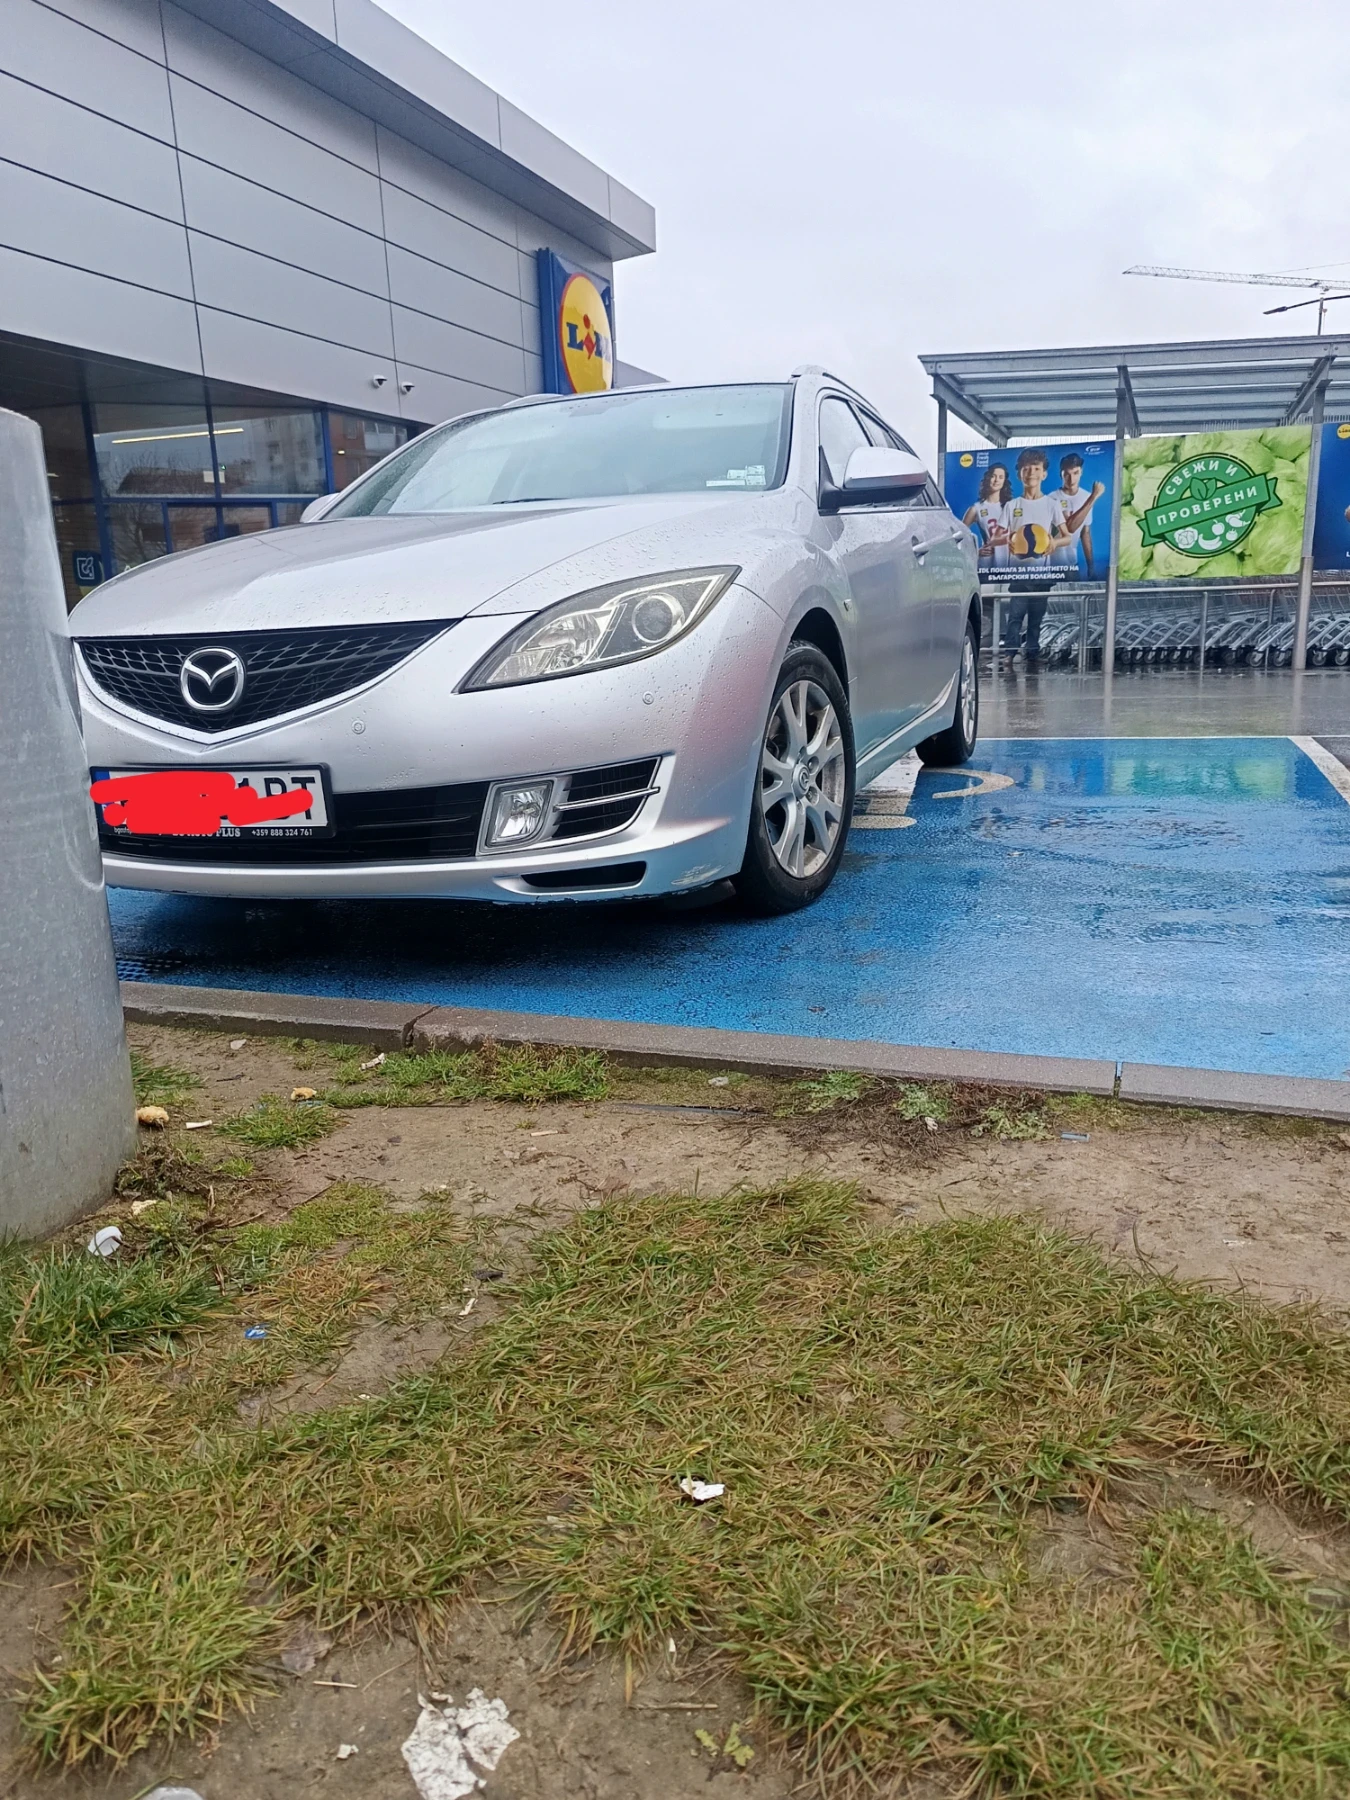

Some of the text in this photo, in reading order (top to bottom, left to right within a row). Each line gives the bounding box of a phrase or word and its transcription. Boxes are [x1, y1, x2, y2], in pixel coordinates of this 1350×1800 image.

[1165, 460, 1238, 495] СВЕЖИ И
[1157, 486, 1257, 526] ПРОВЕРЕНИ
[216, 828, 241, 837] PLUS
